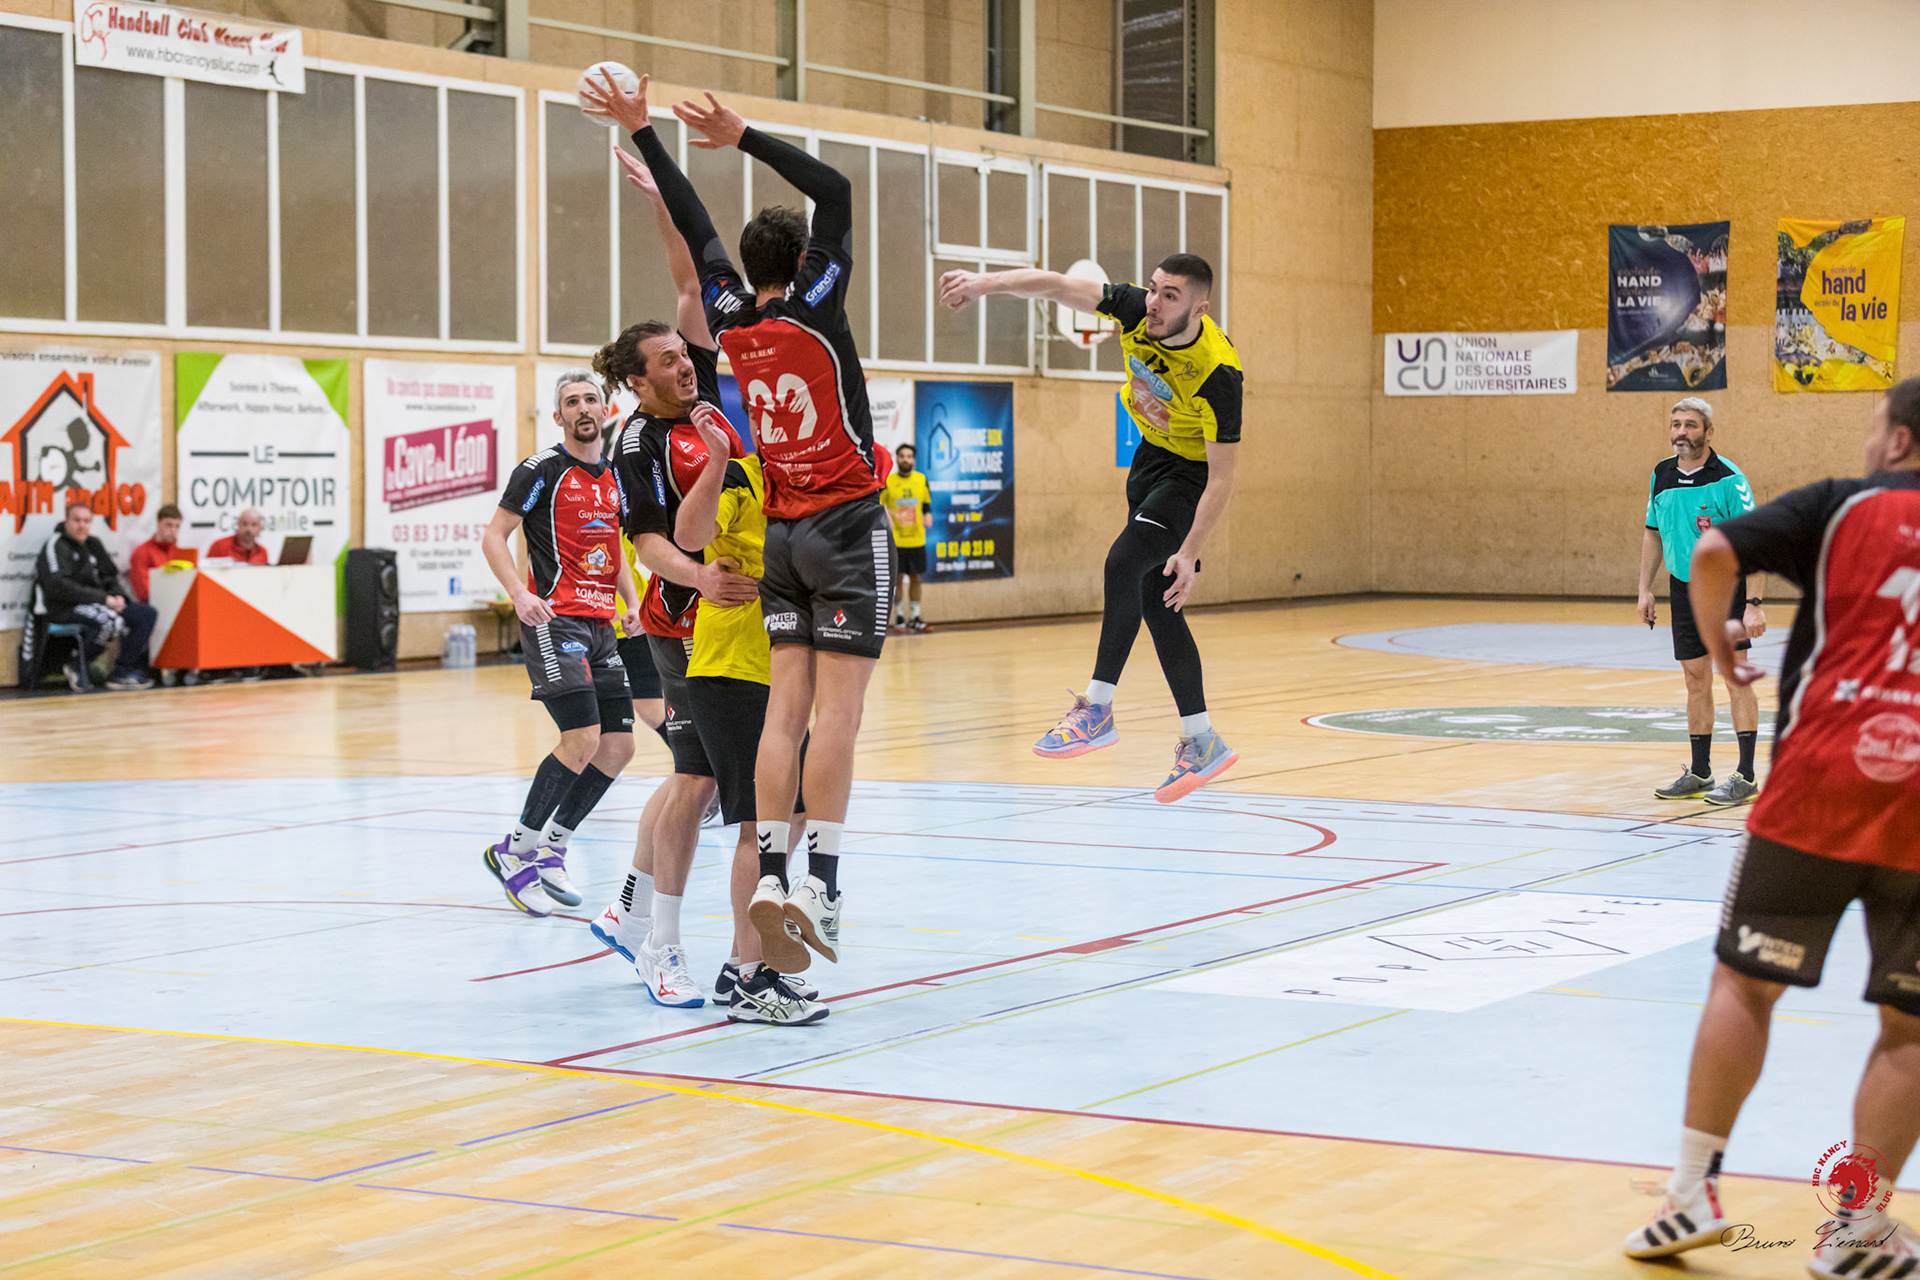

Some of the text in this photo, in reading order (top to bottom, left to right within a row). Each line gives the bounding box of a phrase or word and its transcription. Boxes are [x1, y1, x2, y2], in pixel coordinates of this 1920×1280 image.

[108, 7, 170, 36] Handball
[1617, 275, 1662, 288] HAND
[1822, 268, 1866, 295] hand
[1617, 296, 1661, 308] LA VIE
[1841, 297, 1857, 322] la
[1861, 296, 1888, 321] vie
[1455, 337, 1498, 349] UNION
[1455, 350, 1533, 362] NATIONALE
[1455, 364, 1532, 377] DES CLUBS
[1455, 377, 1568, 391] UNIVERSITAIRES
[253, 445, 275, 464] LE
[393, 436, 436, 491] Cave
[444, 425, 489, 480] Léon
[190, 477, 336, 508] COMPTOIR
[578, 509, 593, 521] Guy
[392, 524, 411, 543] 03
[412, 524, 429, 543] 83
[432, 524, 450, 543] 17
[451, 524, 470, 543] 84
[770, 612, 798, 622] INTER
[769, 621, 798, 632] SPORT
